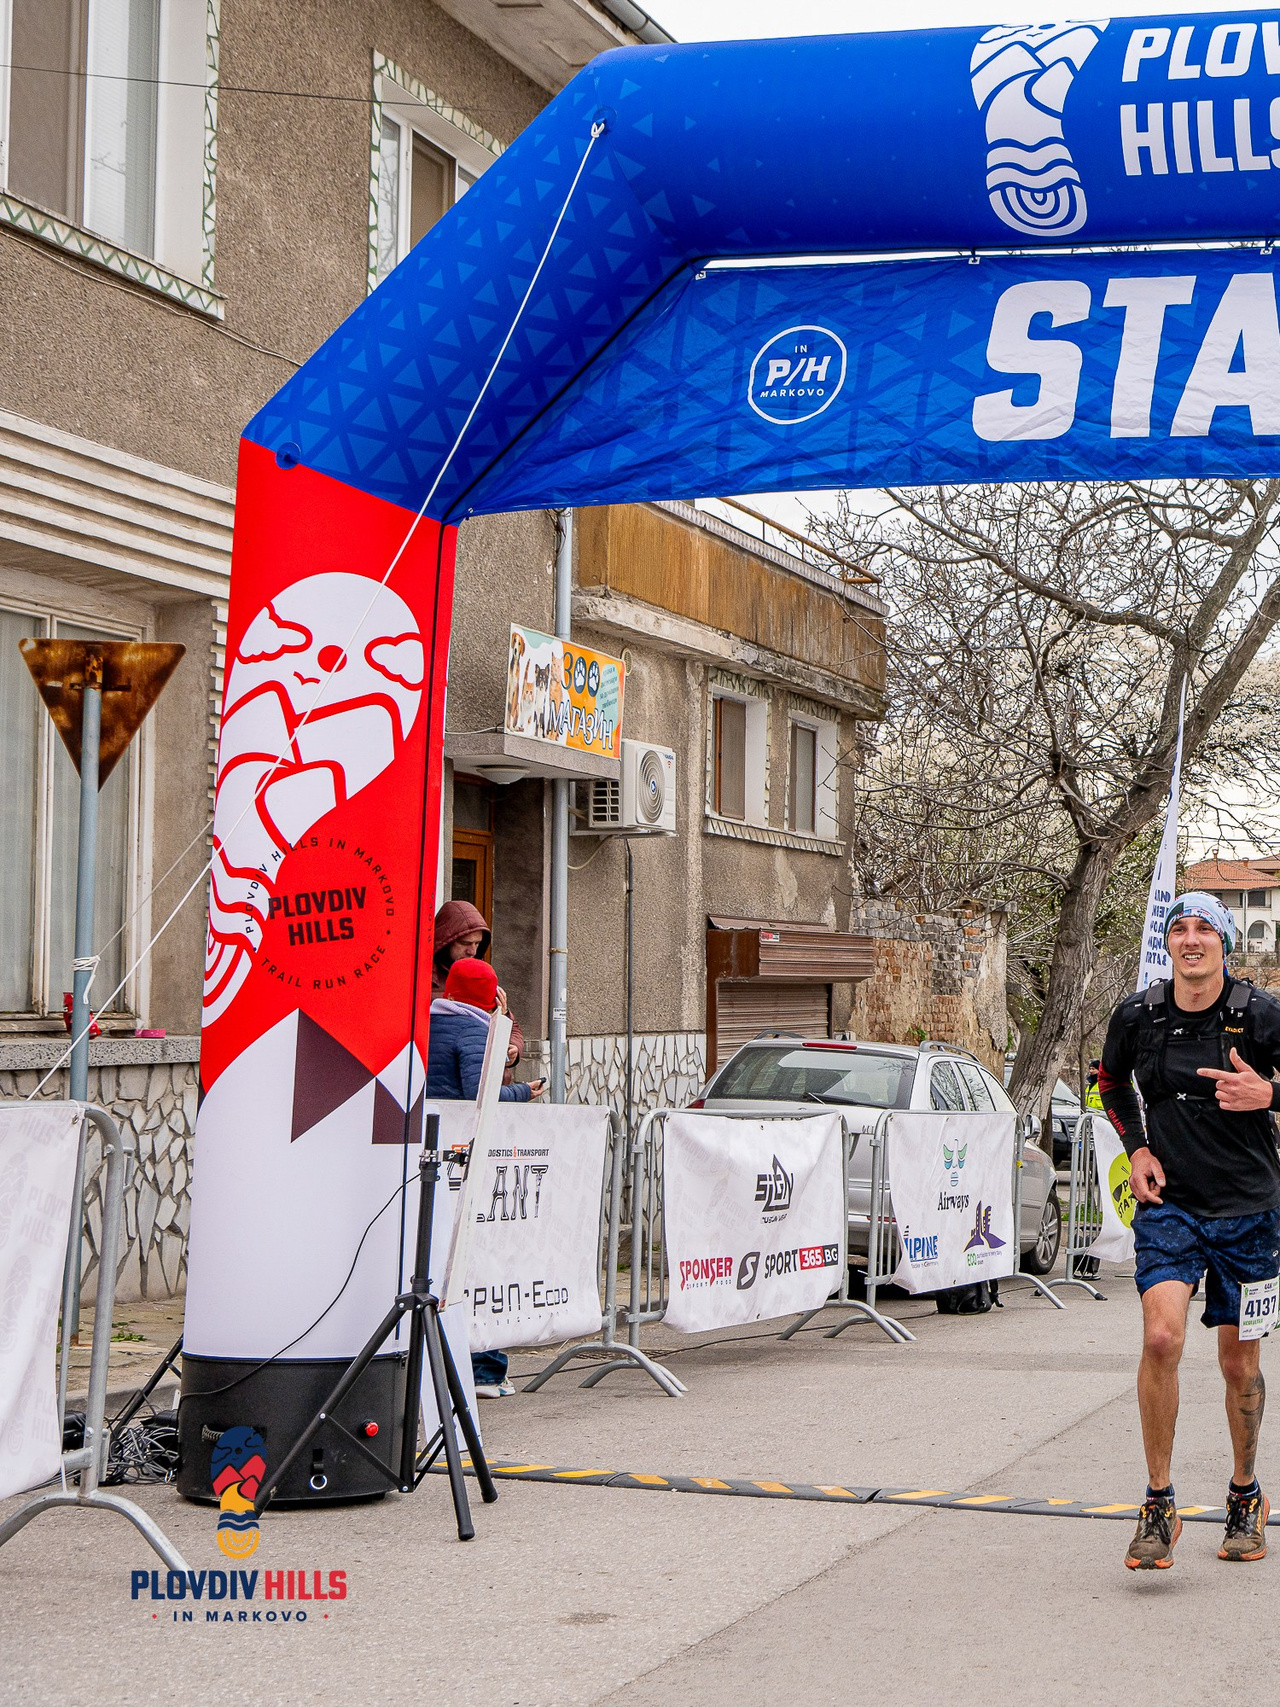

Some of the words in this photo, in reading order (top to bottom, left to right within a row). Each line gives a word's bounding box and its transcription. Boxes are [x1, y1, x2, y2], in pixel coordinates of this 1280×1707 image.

[794, 344, 808, 354] IN
[765, 355, 832, 386] P/H
[760, 388, 825, 398] MARKOVO
[547, 699, 614, 750] МАГАЗИН
[245, 863, 268, 935] PLOVDIV
[270, 837, 318, 862] HILLS
[329, 837, 347, 850] IN
[354, 847, 395, 917] MARKOVO
[268, 886, 367, 921] PLOVDIV
[288, 917, 355, 947] HILLS
[260, 957, 302, 988] TRAIL
[313, 975, 347, 990] RUN
[353, 945, 386, 979] RACE
[517, 1148, 550, 1157] TRANSPORT
[937, 1191, 970, 1213] Airways
[679, 1256, 733, 1292] SPONSER
[764, 1249, 799, 1279] SPORT
[801, 1247, 838, 1269] 365.BG
[1244, 1294, 1277, 1318] 4137
